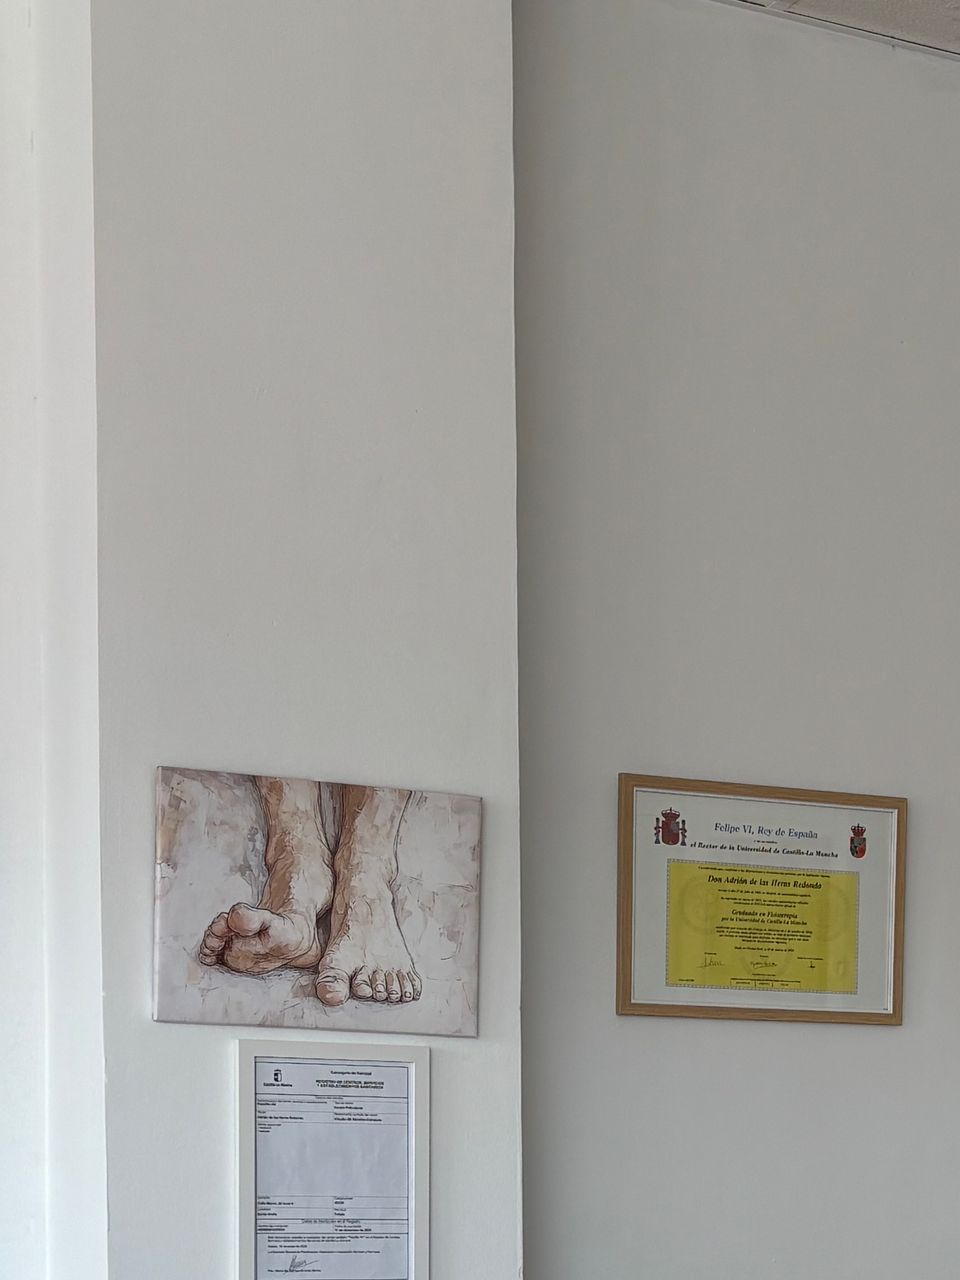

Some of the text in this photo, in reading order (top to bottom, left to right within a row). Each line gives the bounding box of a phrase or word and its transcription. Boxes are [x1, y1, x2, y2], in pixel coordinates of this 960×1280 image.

[714, 822, 818, 839] Felipe VI, Rey de España
[698, 842, 718, 850] Rector
[737, 844, 772, 854] Universidad
[815, 850, 839, 858] Mancha
[708, 875, 723, 884] Don
[724, 876, 748, 885] Adrián
[749, 877, 757, 885] de
[759, 878, 769, 886] las
[793, 880, 822, 890] Redondo
